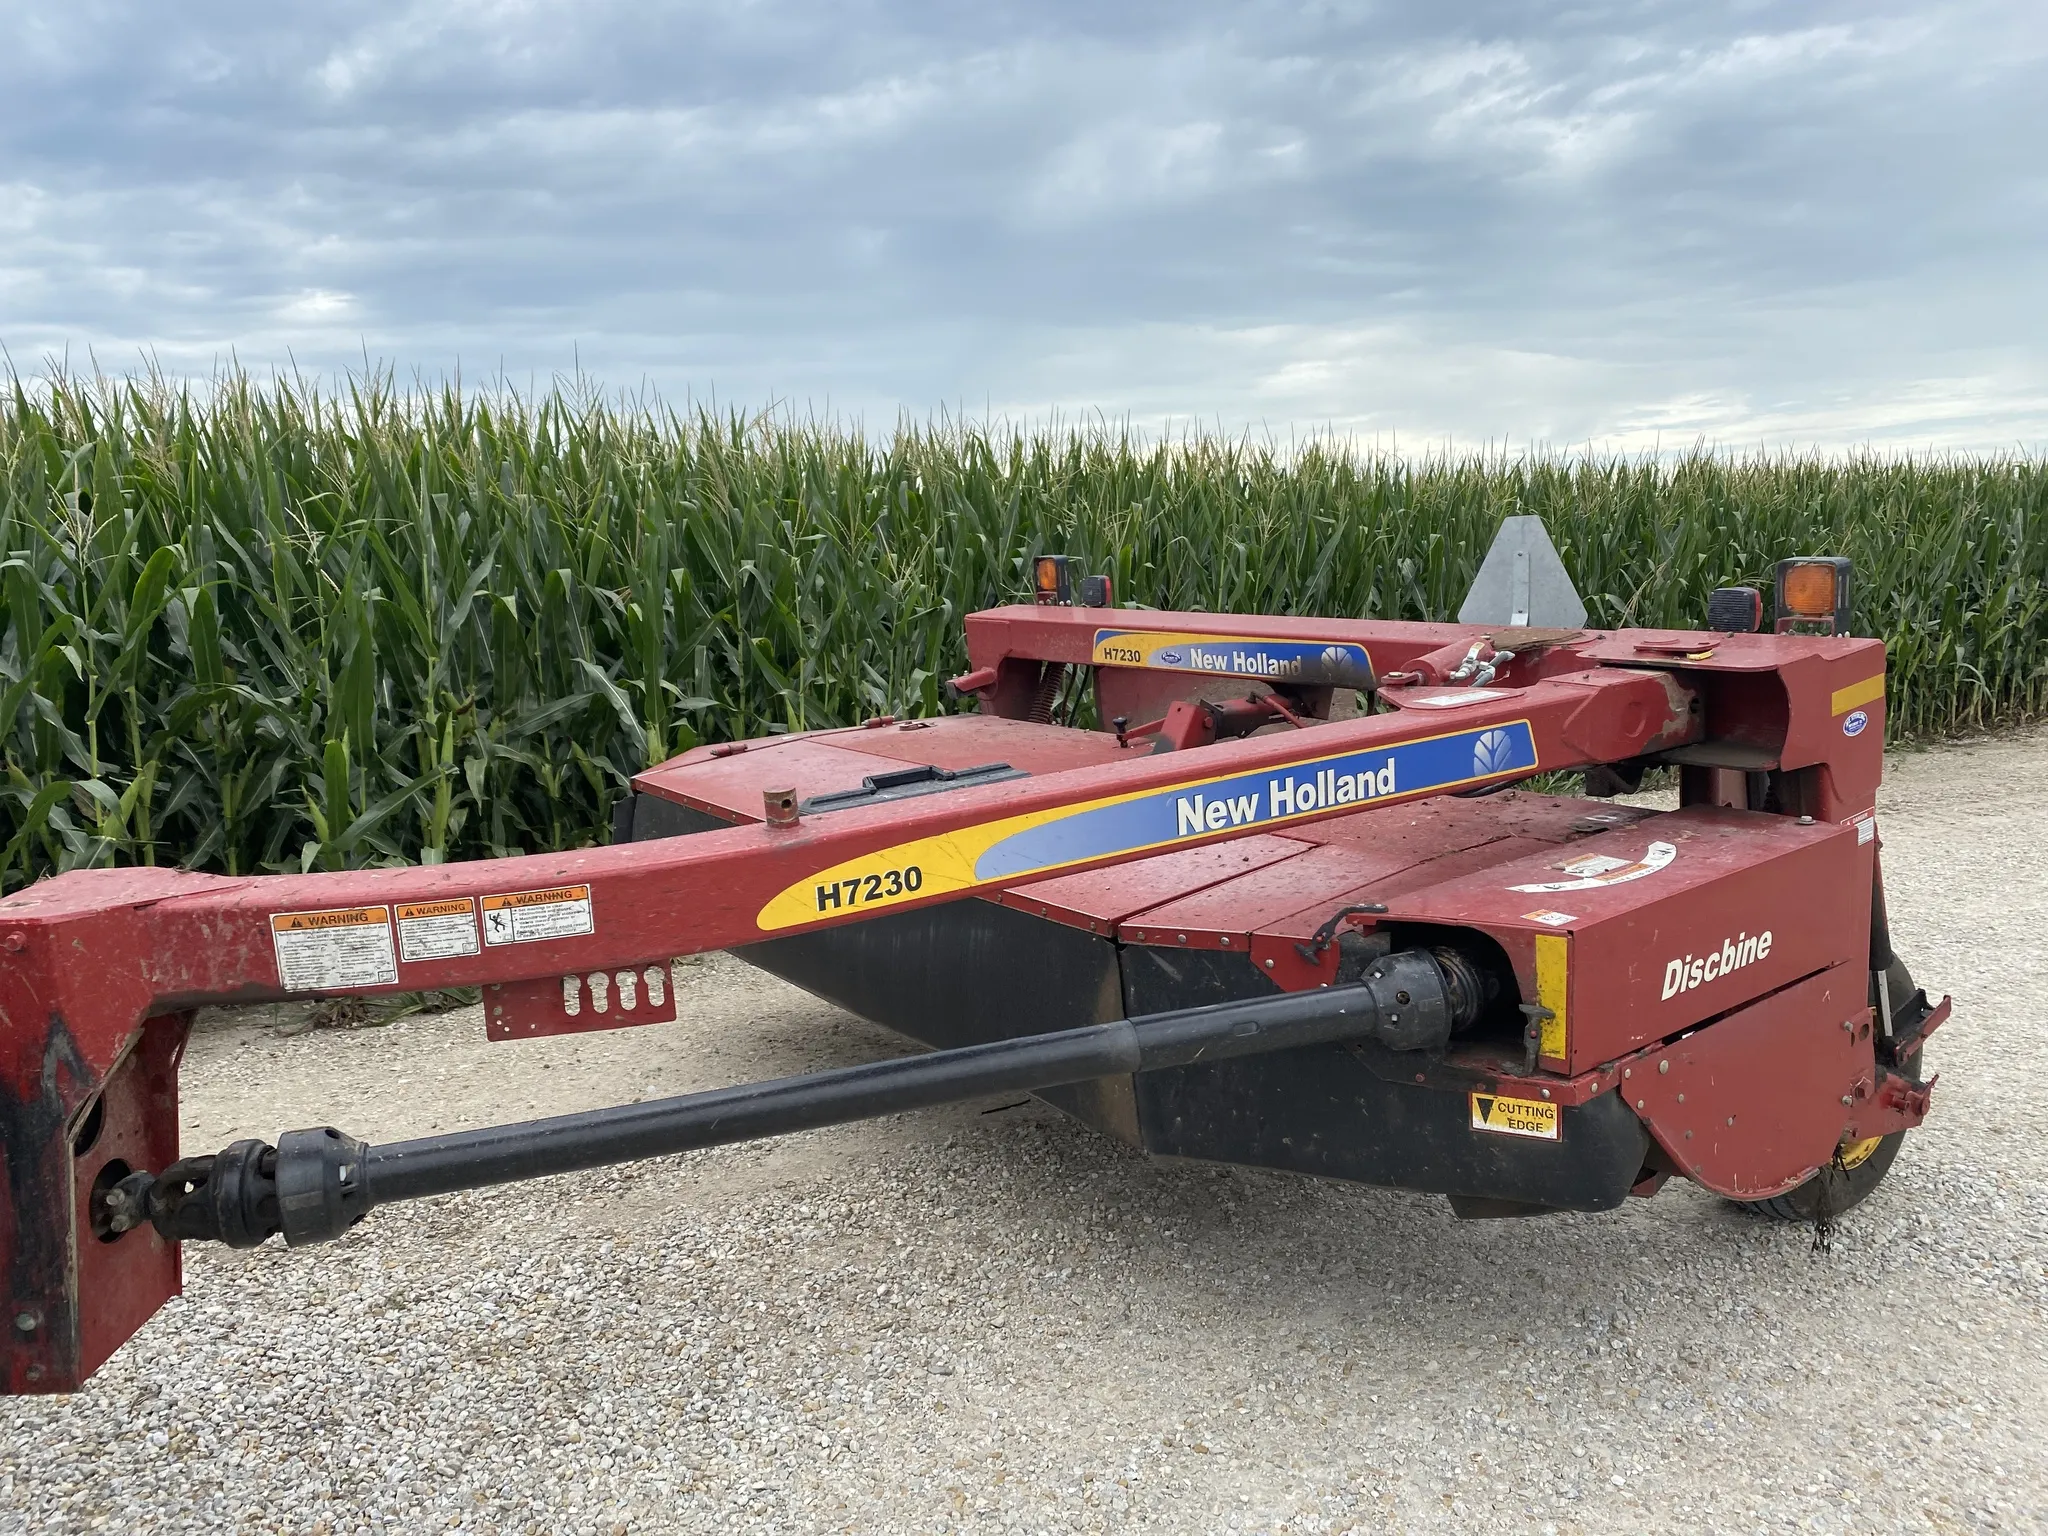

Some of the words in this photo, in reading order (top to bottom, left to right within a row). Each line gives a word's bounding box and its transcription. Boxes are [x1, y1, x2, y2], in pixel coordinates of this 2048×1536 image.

[1103, 647, 1141, 663] H7230
[1190, 648, 1227, 671] New
[1232, 651, 1302, 676] Holland
[1175, 791, 1260, 837] New
[1268, 757, 1396, 819] Holland
[815, 865, 923, 912] H7230
[516, 890, 572, 905] WARNING
[416, 903, 466, 915] WARNING
[308, 912, 368, 926] WARNING
[1660, 928, 1773, 1002] Discbine
[1498, 1102, 1554, 1119] CUTTING
[1509, 1119, 1544, 1133] EDGE
